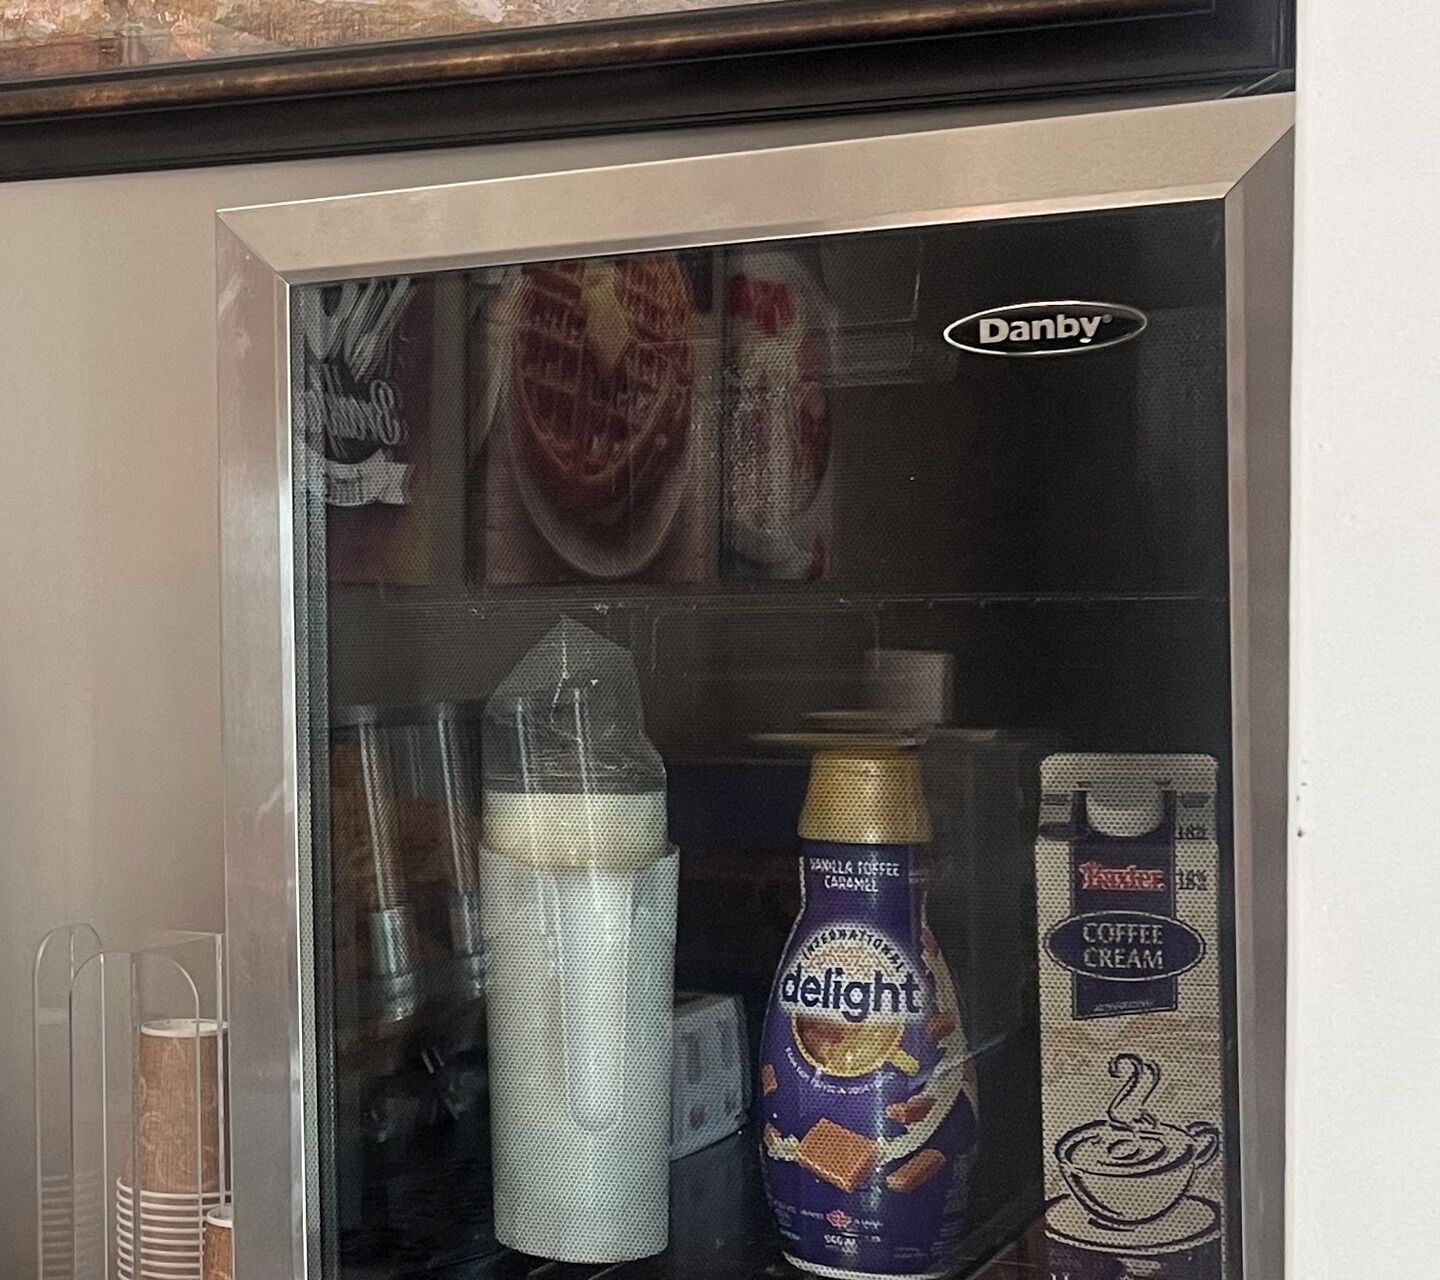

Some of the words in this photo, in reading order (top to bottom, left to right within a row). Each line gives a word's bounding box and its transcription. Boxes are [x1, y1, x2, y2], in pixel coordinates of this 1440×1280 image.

[978, 313, 1102, 345] Danby
[809, 858, 853, 874] VANILLA
[823, 875, 880, 893] CARAMEL
[1081, 923, 1164, 945] COFFEE
[1082, 946, 1164, 970] CREAM
[781, 963, 923, 1023] delight
